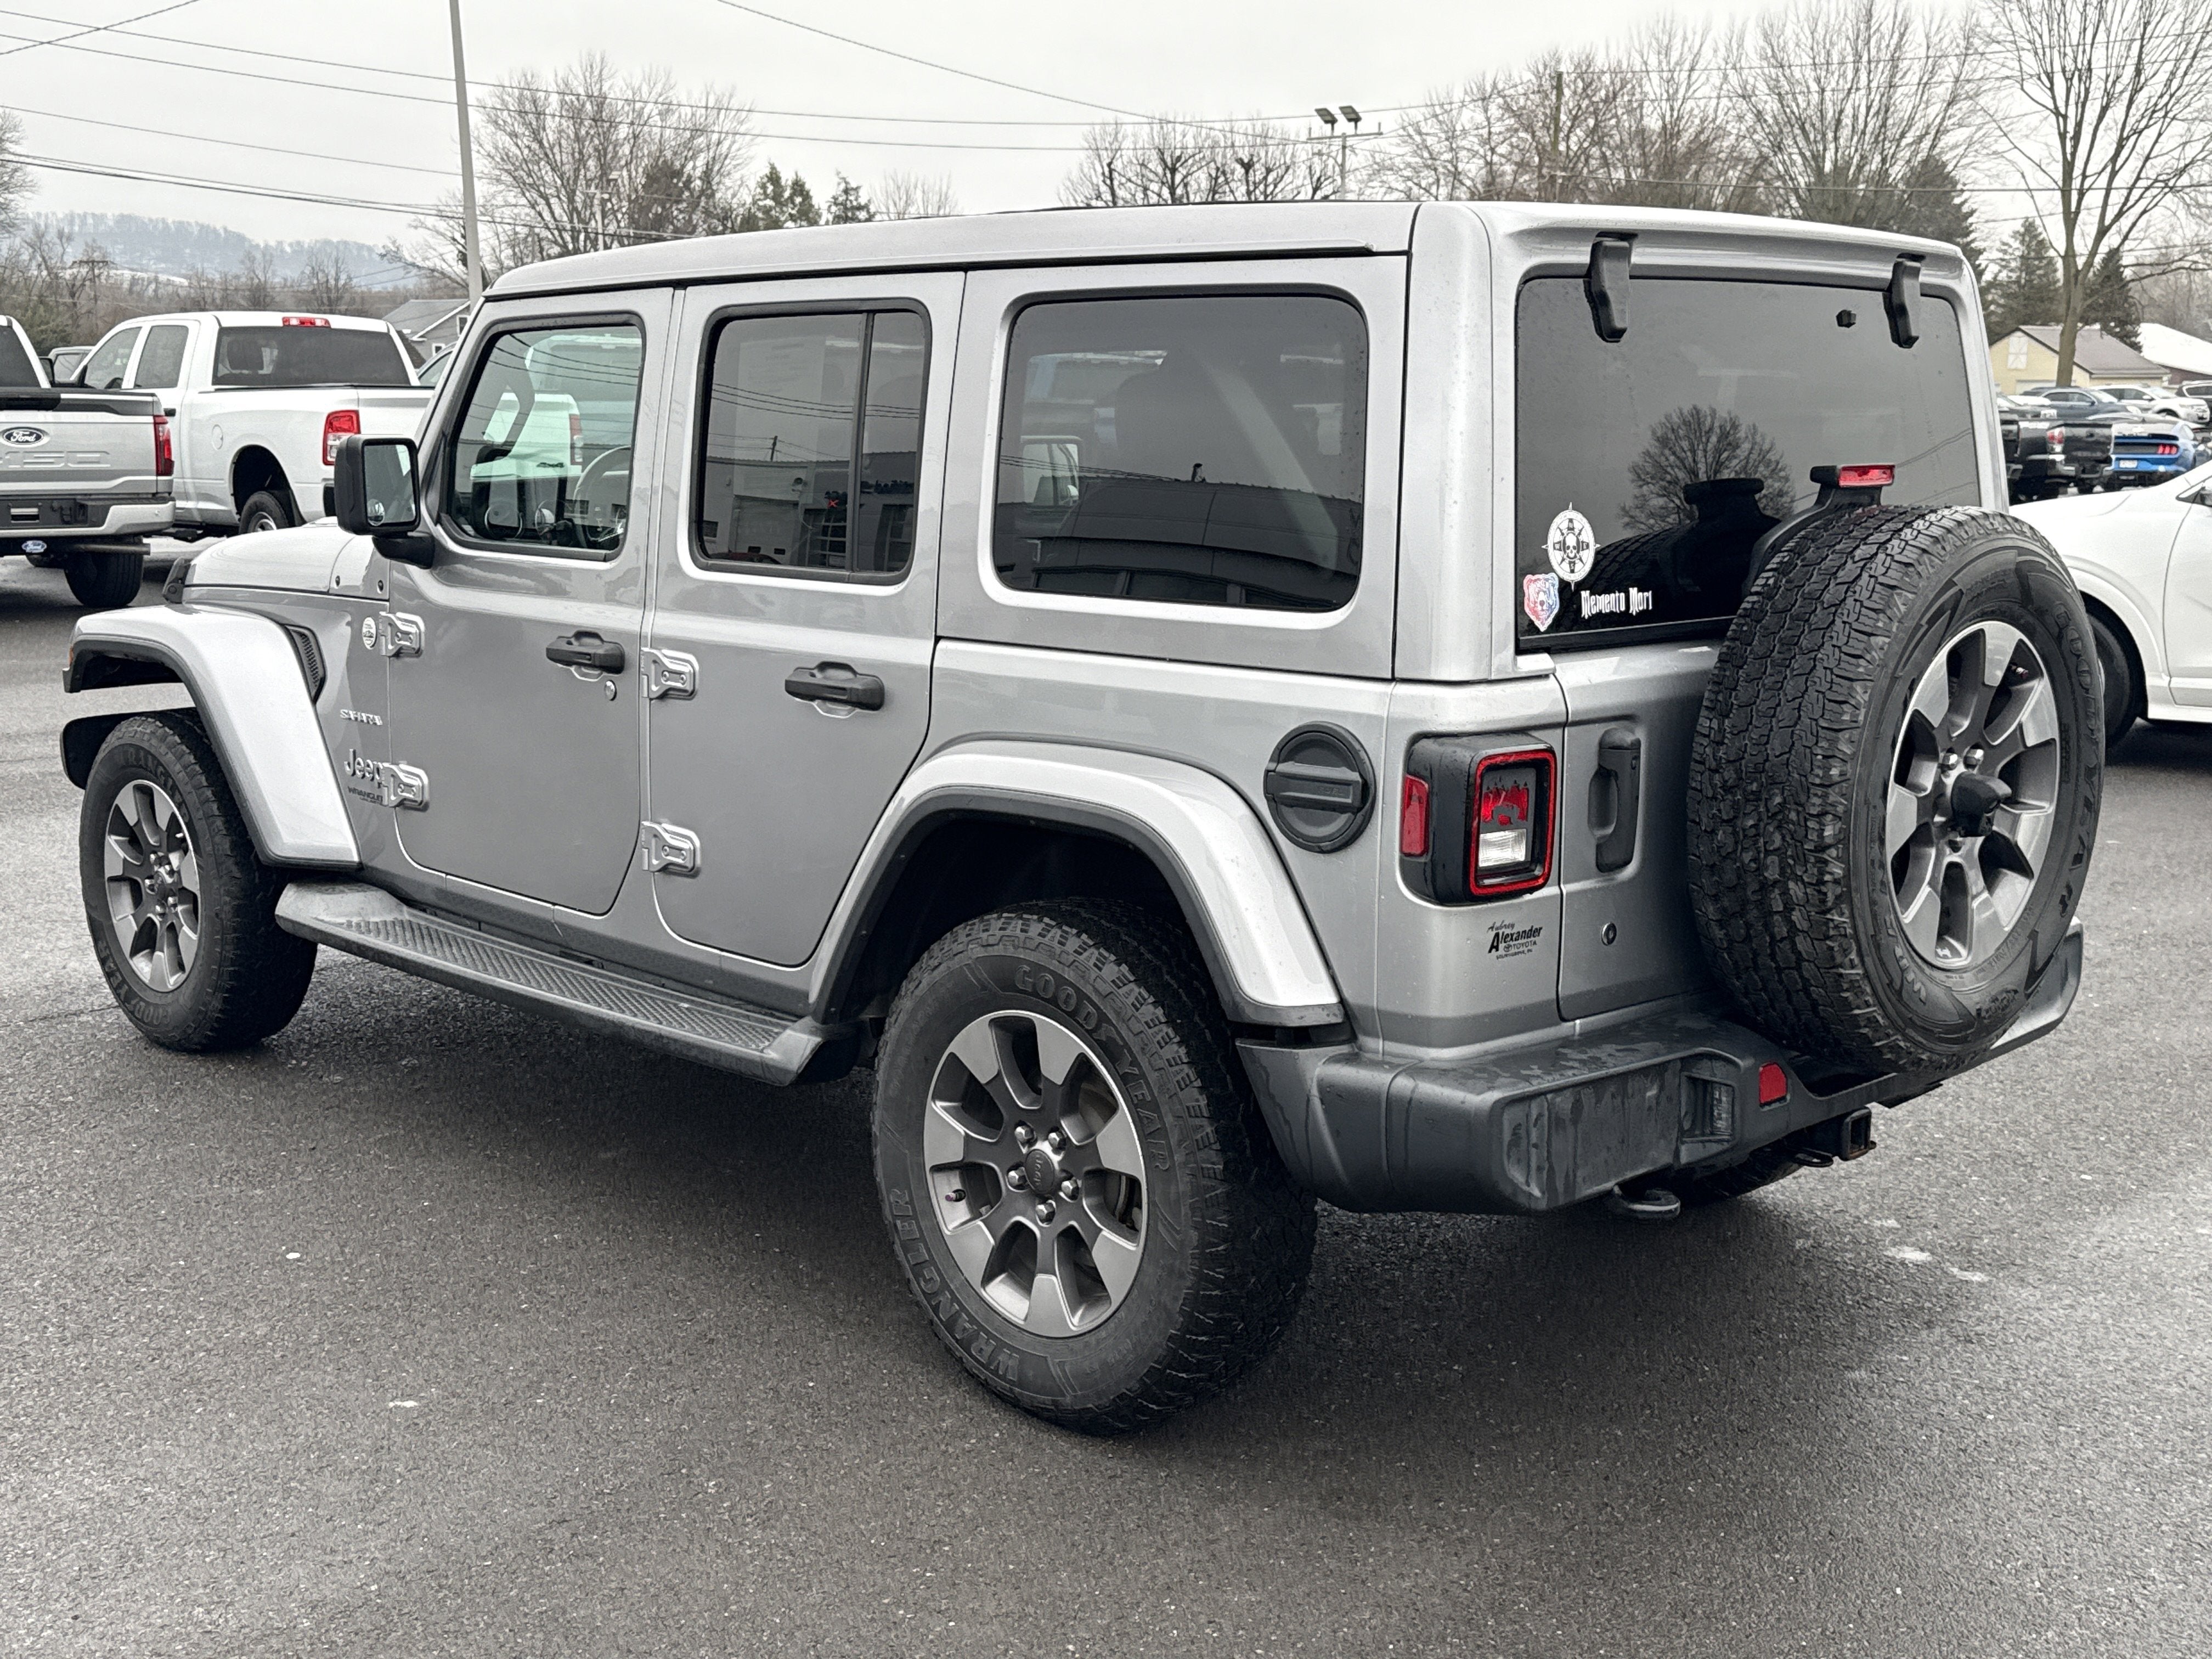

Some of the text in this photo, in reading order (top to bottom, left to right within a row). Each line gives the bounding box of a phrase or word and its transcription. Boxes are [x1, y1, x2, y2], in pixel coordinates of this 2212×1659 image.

[10, 431, 37, 442] Ford
[1581, 590, 1626, 619] Memento
[1488, 925, 1543, 953] Alexander
[1513, 940, 1537, 950] TOYOTA
[1014, 964, 1170, 1171] GOODYEAR
[890, 1189, 1020, 1381] WRANGLER
